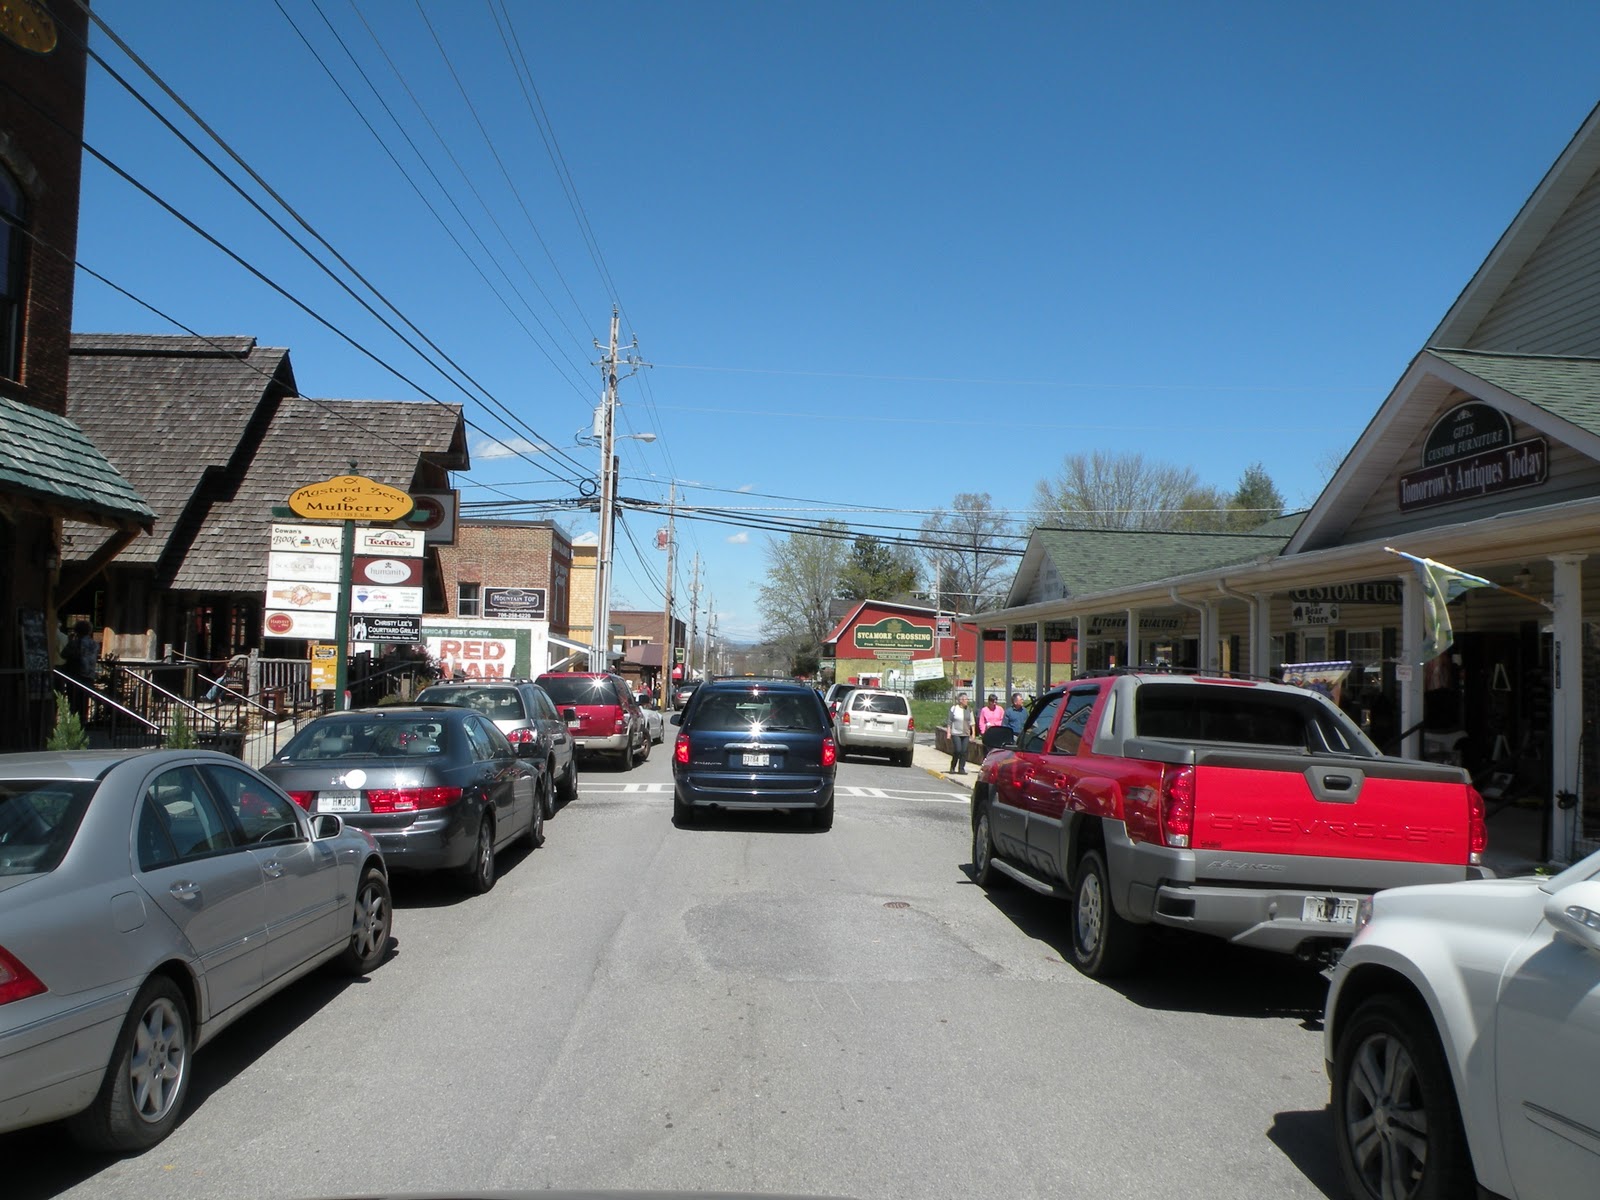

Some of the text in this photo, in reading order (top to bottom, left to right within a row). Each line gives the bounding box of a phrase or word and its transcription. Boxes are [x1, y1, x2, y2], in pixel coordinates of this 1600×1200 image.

[1453, 422, 1474, 440] GIFTS
[1428, 430, 1502, 461] CUSTOM FURNITURE
[1401, 448, 1542, 503] Tomorrow's Antiques Today
[297, 487, 405, 503] Mustard Seed
[306, 502, 394, 514] Mulberry
[370, 567, 406, 578] humanity
[1295, 584, 1359, 600] CUSTOM
[1305, 606, 1323, 615] Bear
[1139, 618, 1179, 628] ECIALTIES
[1308, 615, 1328, 624] Store
[368, 626, 399, 634] COURTYARD
[857, 632, 892, 640] SYCAMORE
[440, 640, 506, 660] RED
[440, 662, 504, 682] MAN
[1209, 812, 1456, 844] CHEVROLET
